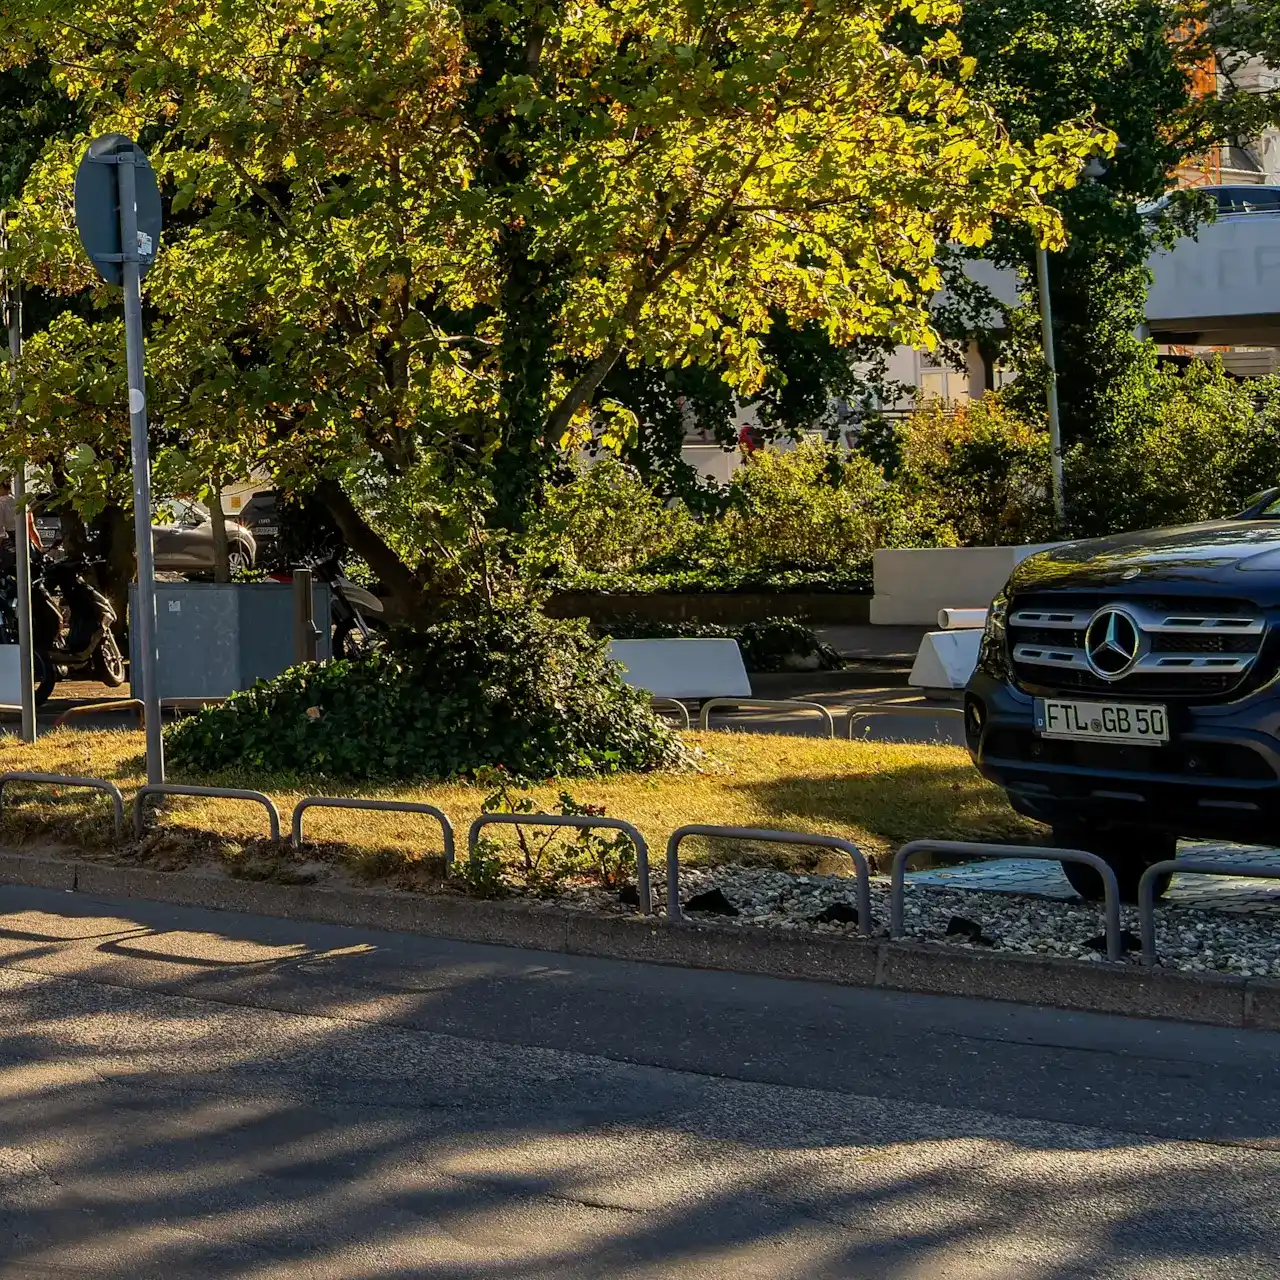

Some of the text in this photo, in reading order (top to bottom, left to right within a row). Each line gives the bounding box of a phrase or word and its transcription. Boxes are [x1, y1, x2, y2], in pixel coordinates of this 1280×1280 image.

[1046, 703, 1164, 735] FTL GB 50
